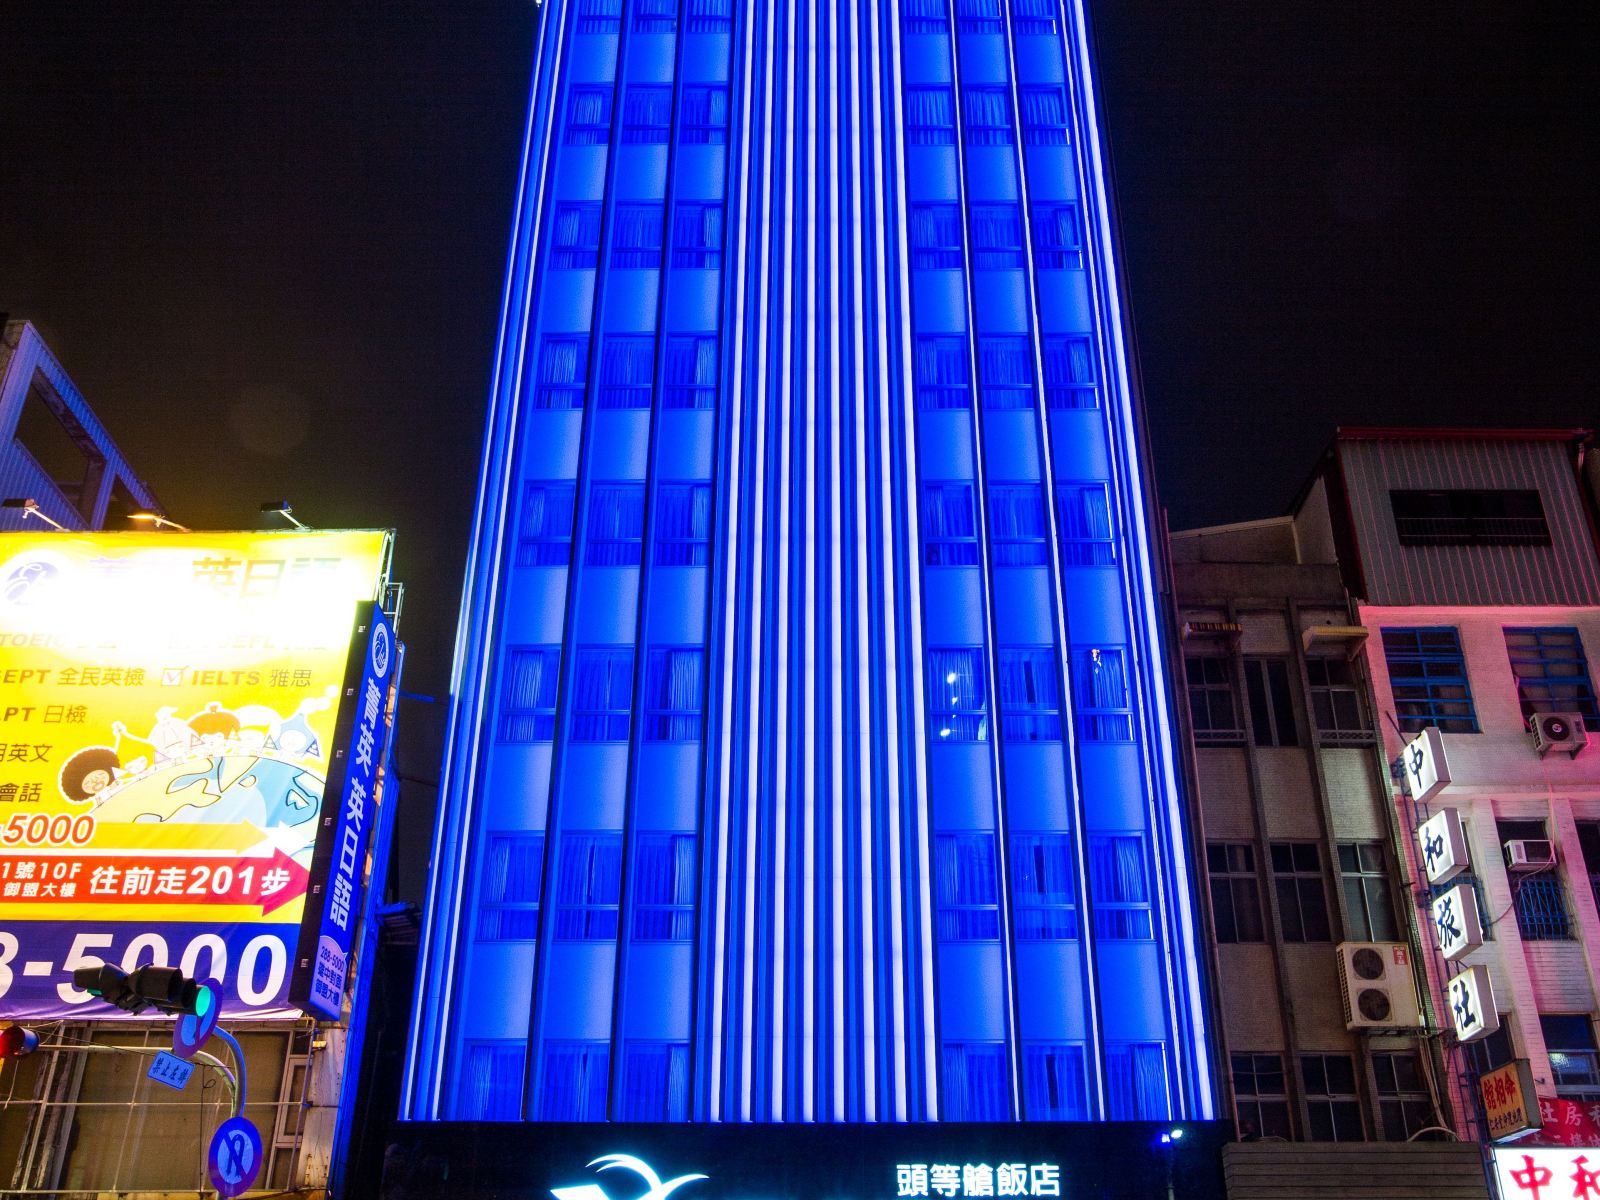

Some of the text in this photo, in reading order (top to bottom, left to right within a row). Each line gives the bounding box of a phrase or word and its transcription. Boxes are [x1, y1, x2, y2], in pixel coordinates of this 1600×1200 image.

[0, 667, 146, 686] EPT 全民英檢
[192, 669, 312, 687] IELTS 雅思
[0, 705, 88, 723] PT 日檢
[90, 865, 290, 896] 往前走201步
[896, 1162, 1060, 1197] 頭等艙飯店
